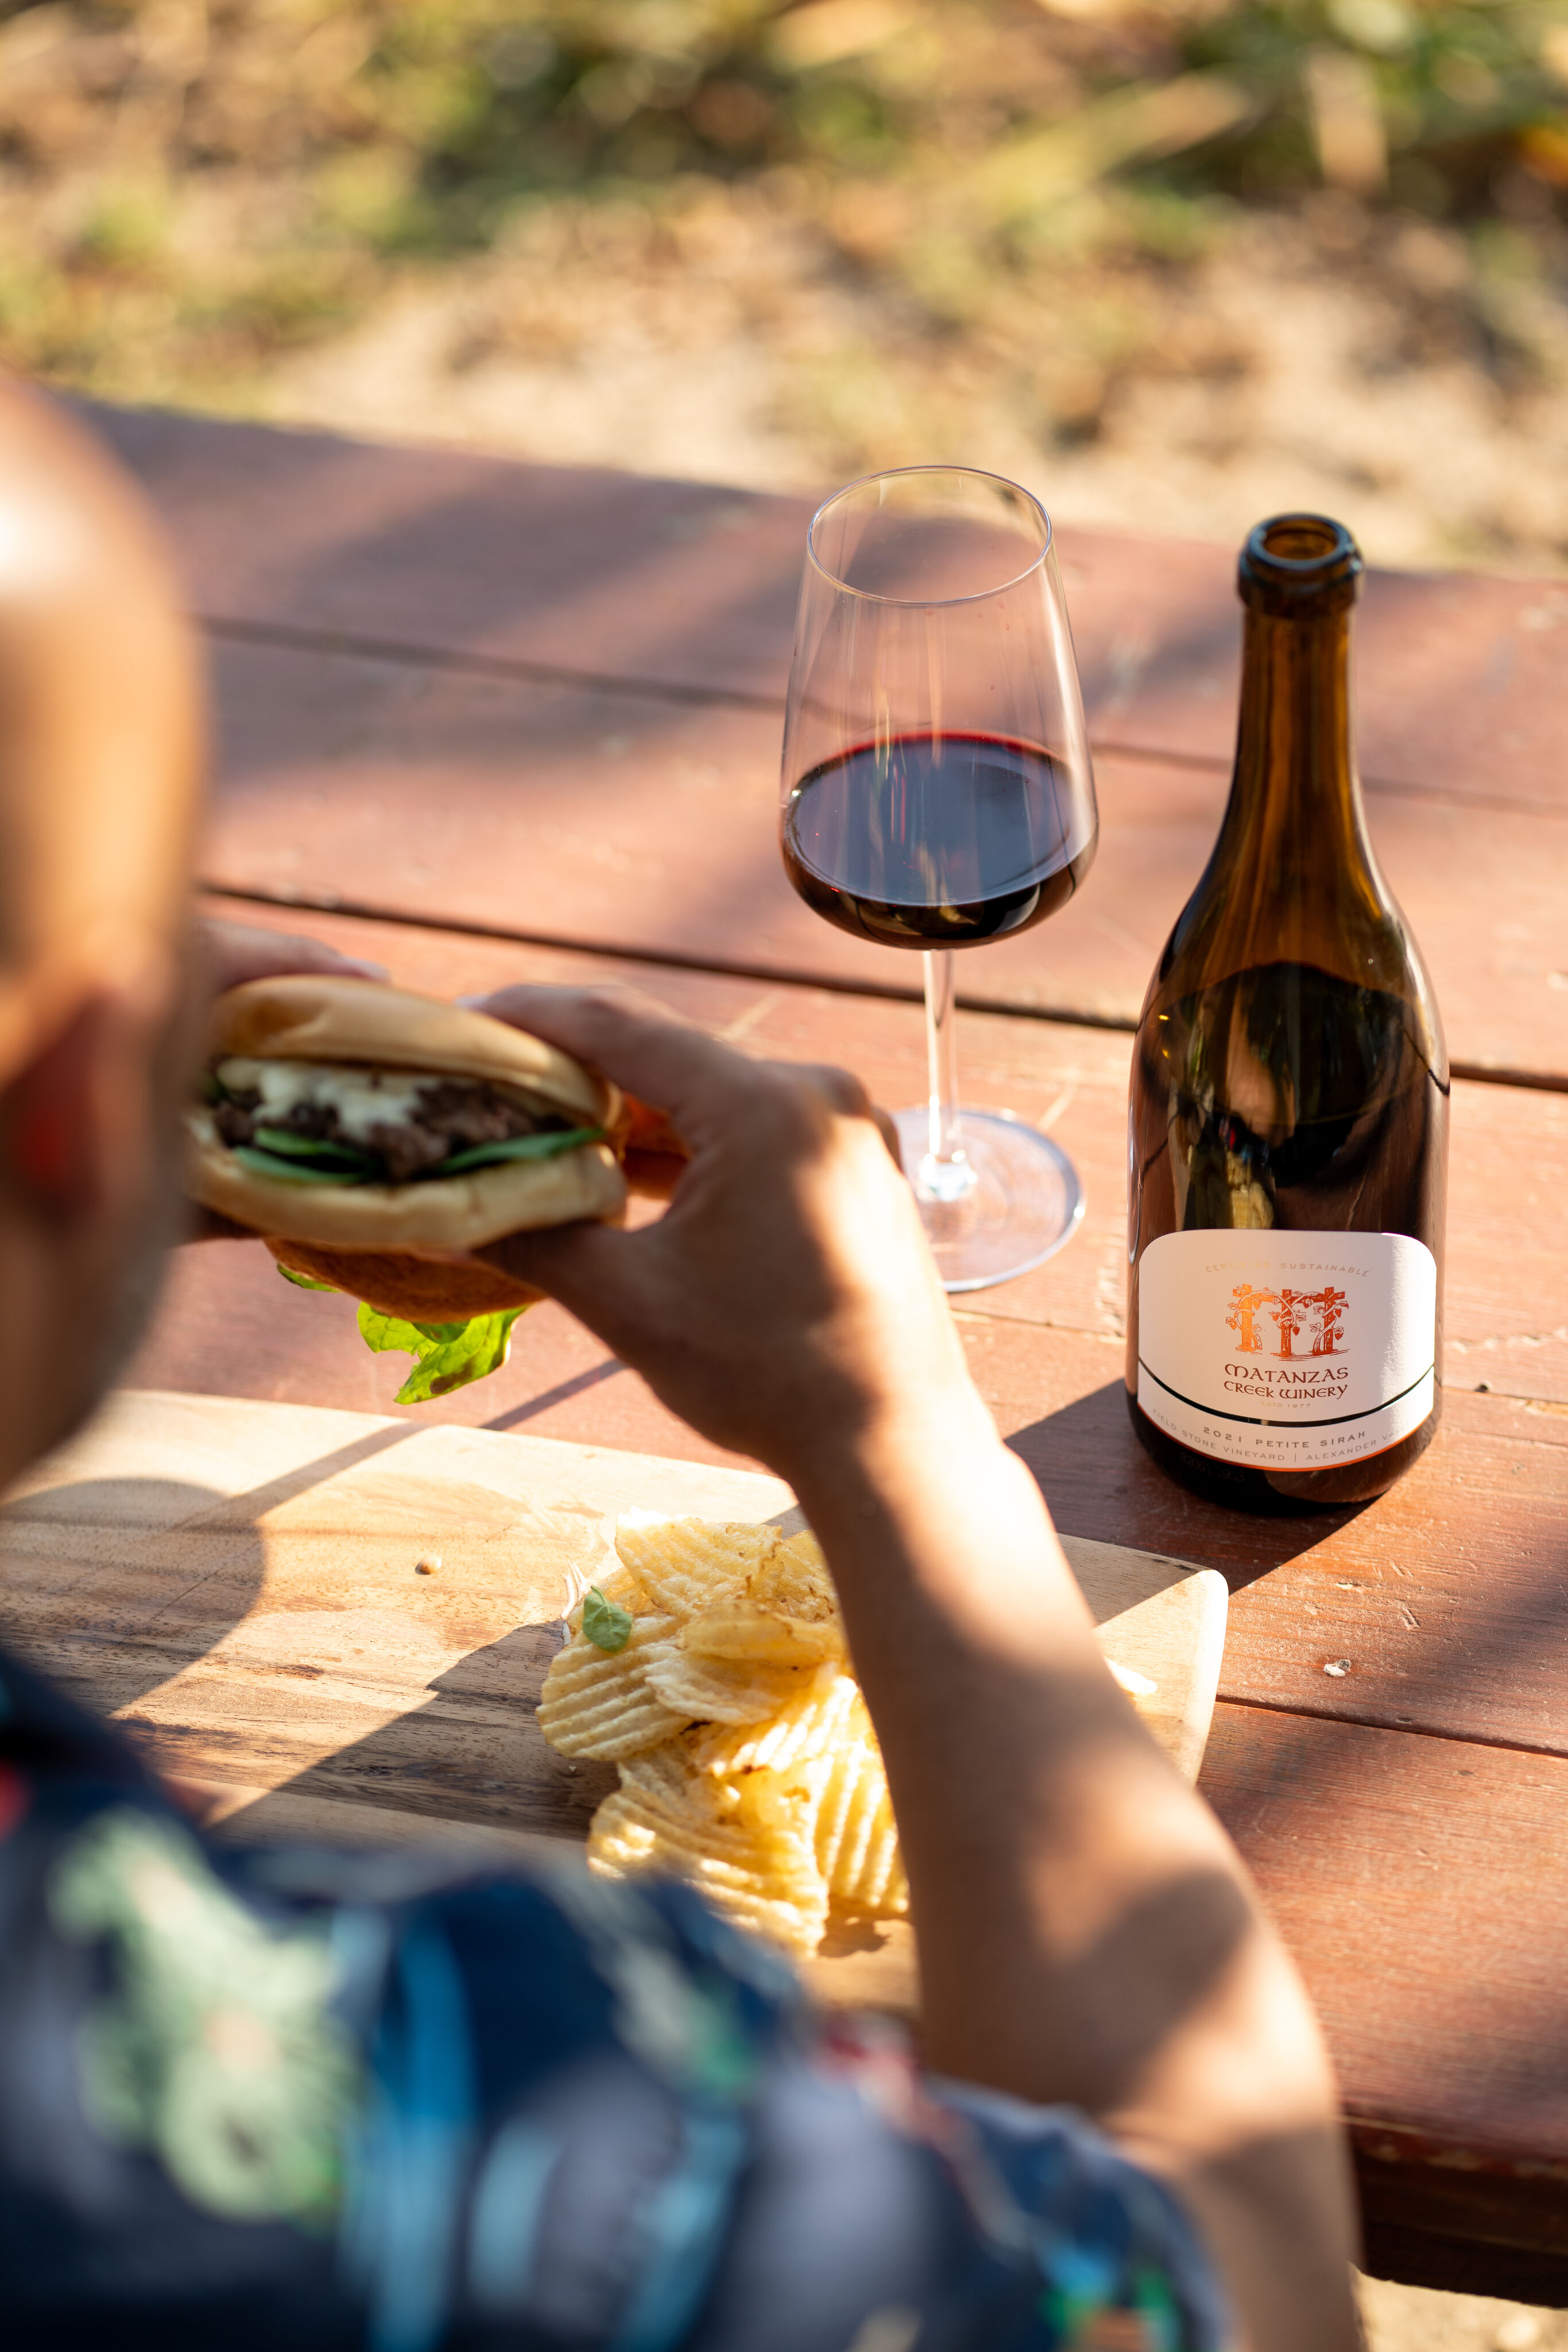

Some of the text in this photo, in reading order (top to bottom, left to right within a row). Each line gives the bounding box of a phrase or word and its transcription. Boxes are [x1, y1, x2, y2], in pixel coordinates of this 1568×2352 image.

[1206, 1260, 1370, 1277] CERTIFIED SUSTAINABLE
[1224, 1363, 1349, 1384] MATANZAS
[1279, 1383, 1349, 1400] WINERY
[1182, 1429, 1217, 1449] STONE
[1222, 1445, 1286, 1461] VINEYARD
[1305, 1438, 1377, 1461] ALEXANDER
[1203, 1426, 1366, 1449] 2021 PETITE SIRAH
